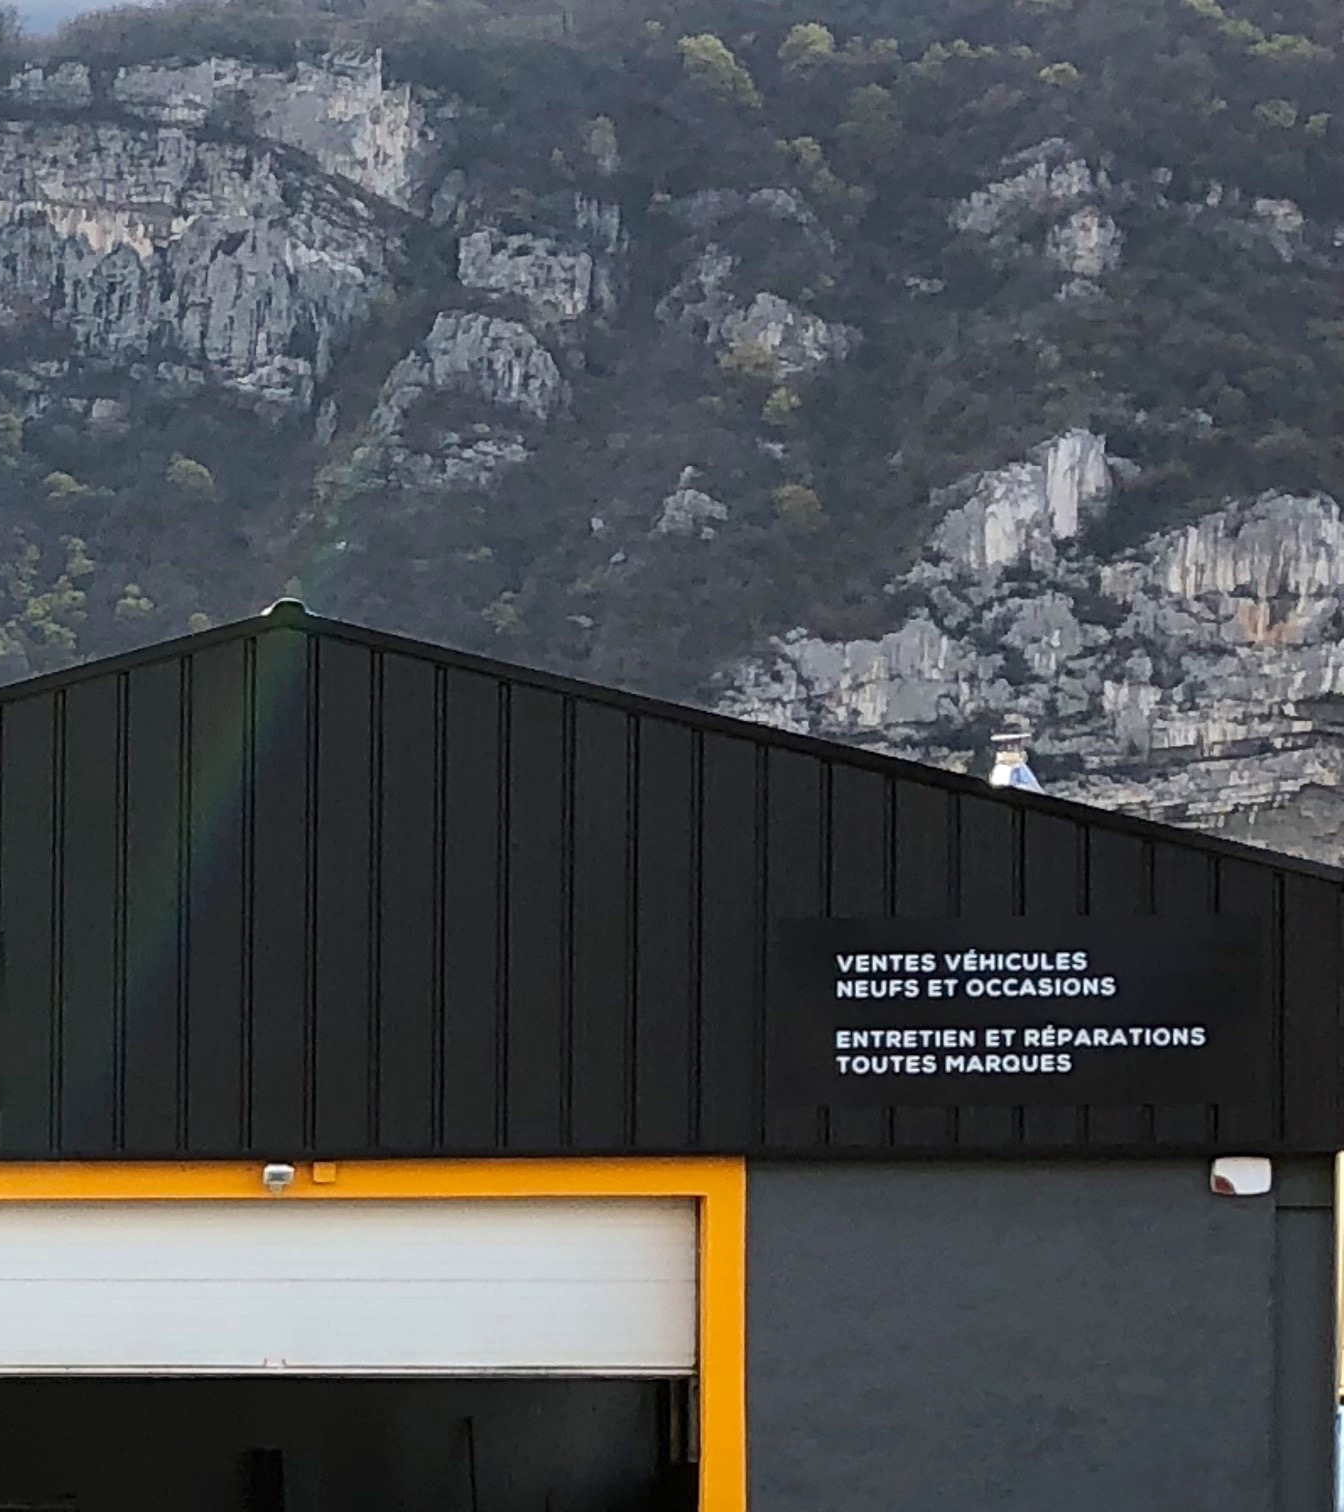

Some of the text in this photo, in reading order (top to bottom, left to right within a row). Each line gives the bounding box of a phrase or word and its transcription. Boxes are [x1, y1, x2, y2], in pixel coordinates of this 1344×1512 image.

[836, 948, 1088, 973] VENTES VÉHICULES
[836, 977, 1117, 998] NEUFS ET OCCASIONS
[836, 1024, 1207, 1049] ENTRETIEN ET RÉPARATIONS
[836, 1054, 1072, 1075] TOUTES MARQUES
